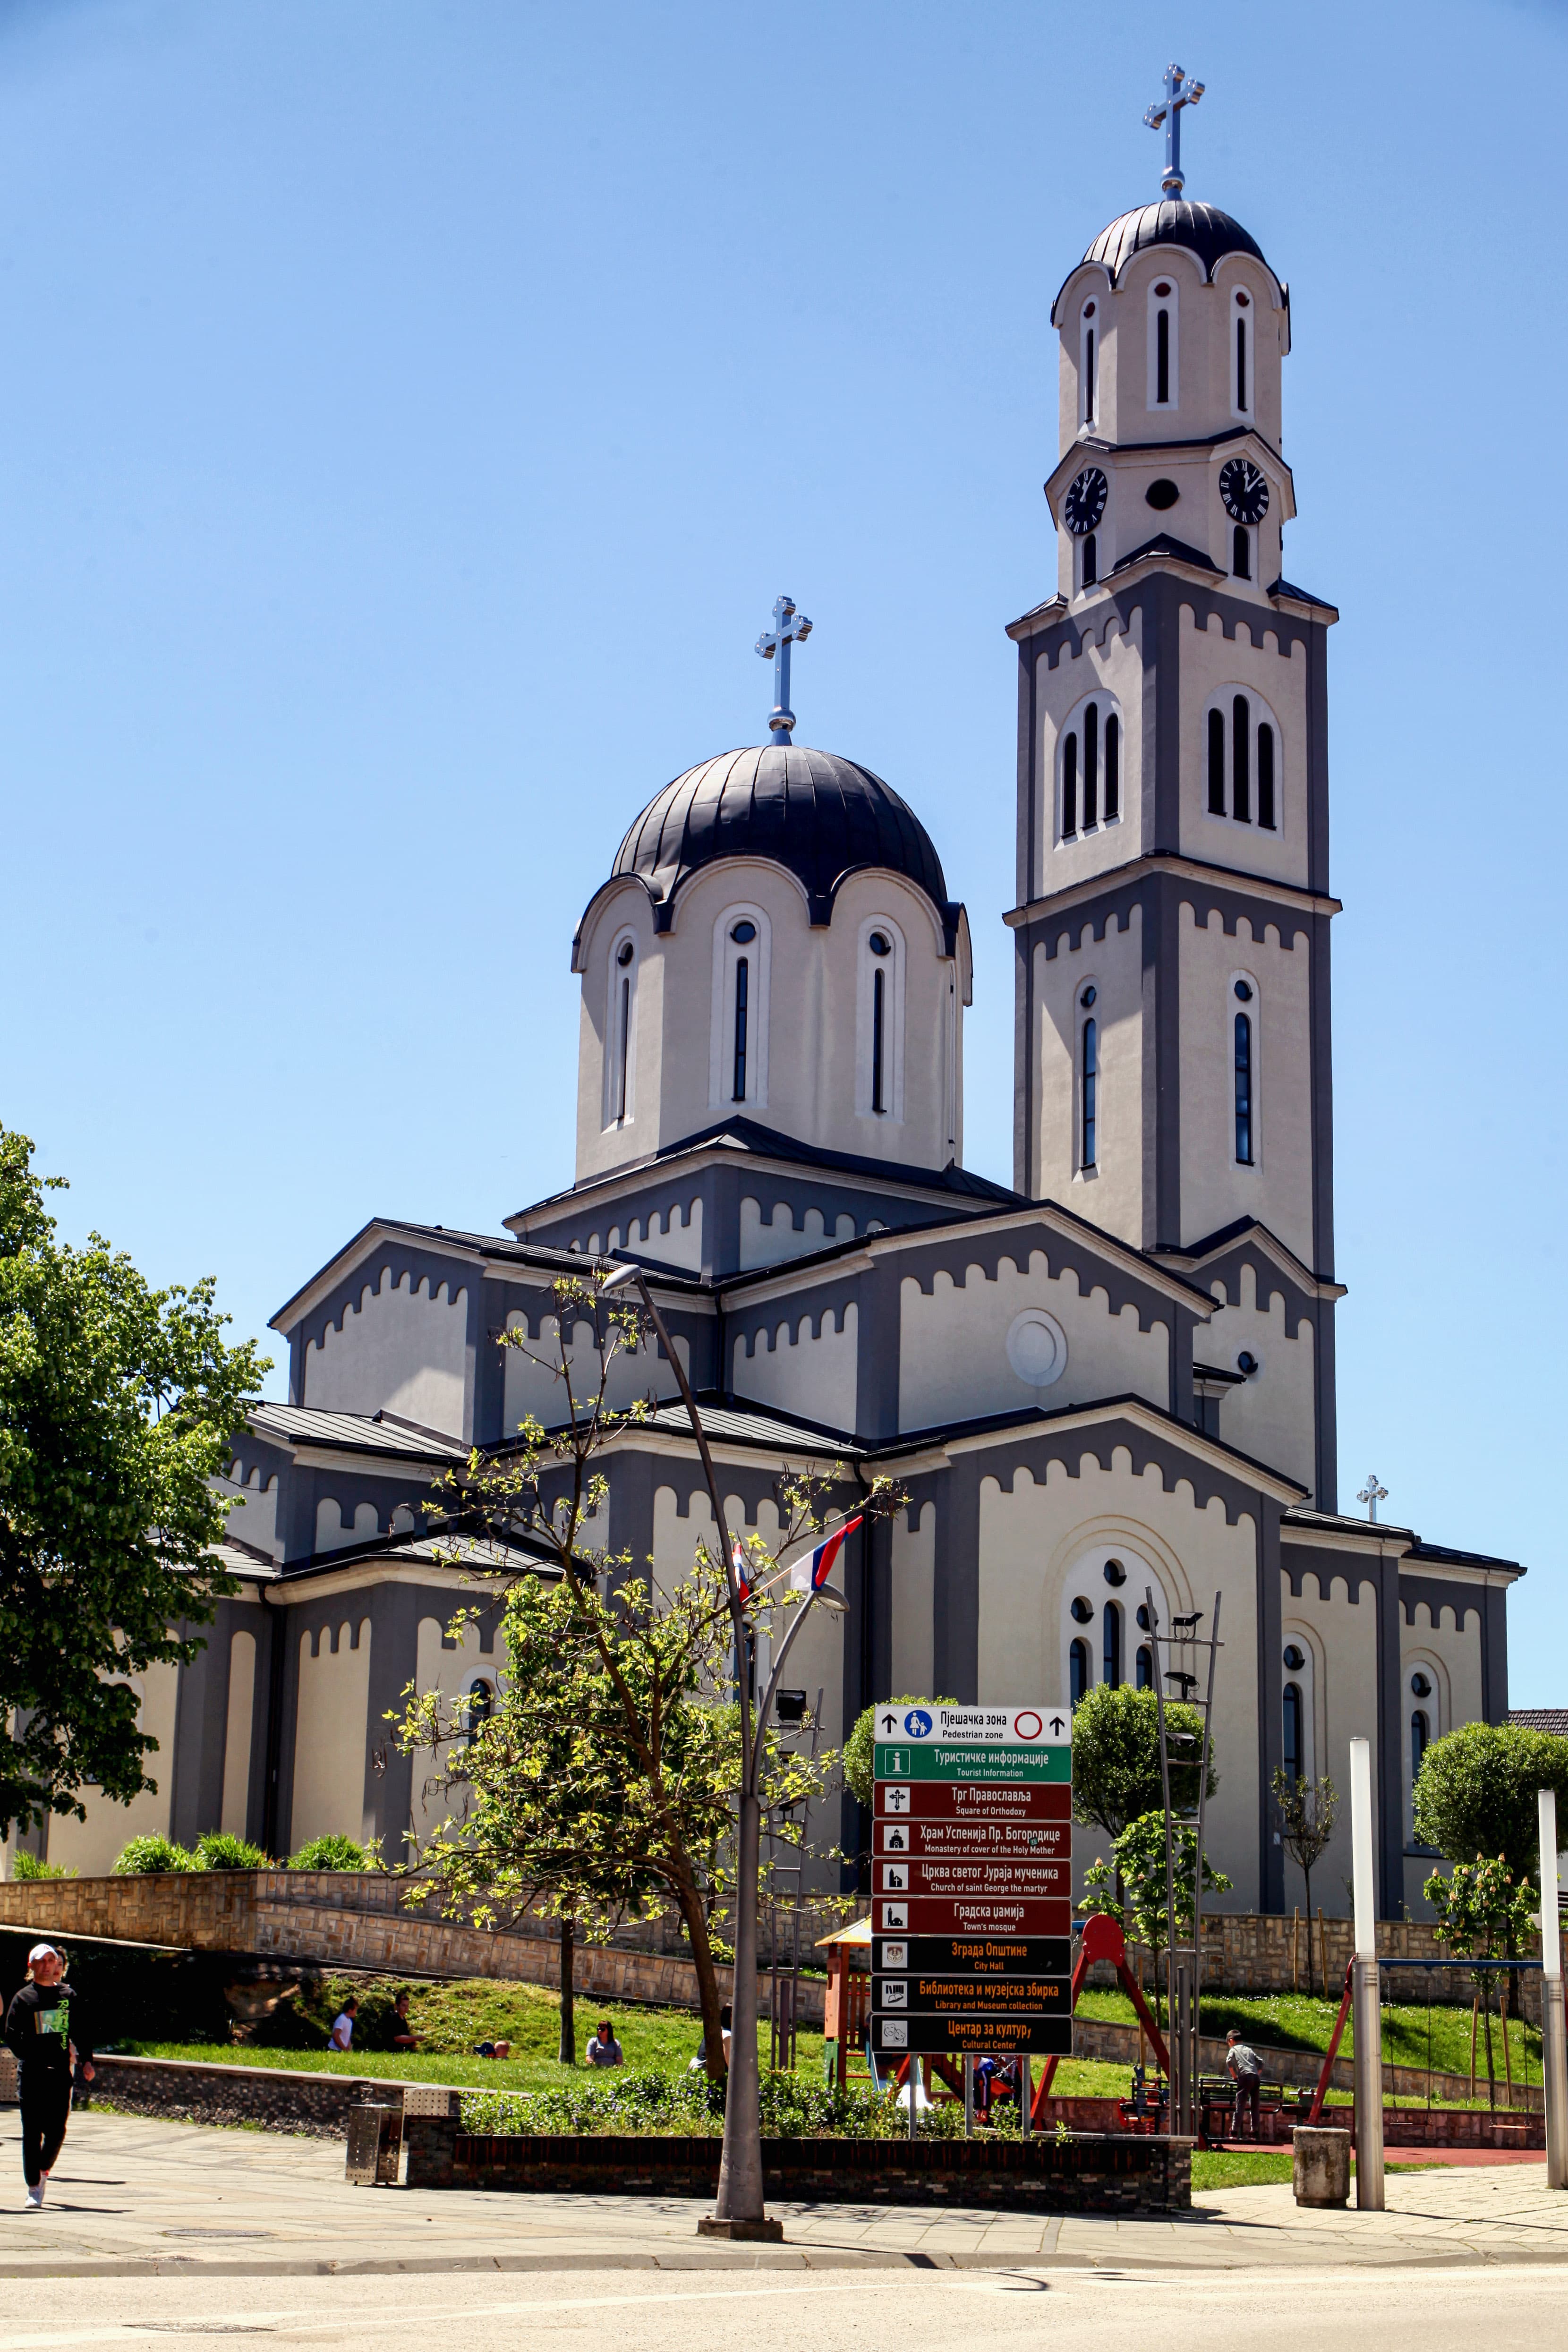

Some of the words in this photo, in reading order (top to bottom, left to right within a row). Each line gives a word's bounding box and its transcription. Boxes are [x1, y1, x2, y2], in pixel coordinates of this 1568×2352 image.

[941, 1711, 984, 1728] Пјешачка
[986, 1715, 1007, 1725] зона
[943, 1730, 983, 1738] Pedestrian
[934, 1749, 986, 1766] Туристичке
[989, 1750, 1048, 1768] информације
[957, 1768, 981, 1776] Tourist
[983, 1768, 1023, 1777] Information
[952, 1787, 967, 1804] Трг
[969, 1787, 1031, 1804] Православља
[956, 1806, 980, 1816] Square
[982, 1807, 989, 1815] of
[990, 1807, 1026, 1817] Orthodoxy
[920, 1825, 944, 1842] Храм
[946, 1825, 986, 1843] Успенија
[989, 1826, 1003, 1843] Пр.
[1006, 1826, 1060, 1844] Богородице
[925, 1844, 961, 1855] Monastery
[963, 1844, 970, 1853] of
[991, 1845, 999, 1853] of
[1000, 1845, 1011, 1854] the
[1013, 1845, 1028, 1856] Holy
[1030, 1846, 1055, 1854] Mother
[922, 1864, 950, 1881] Црква
[952, 1867, 982, 1878] светог
[983, 1865, 1012, 1882] Јураја
[1014, 1868, 1058, 1882] мученика
[931, 1883, 955, 1892] Church
[957, 1883, 964, 1892] of
[965, 1883, 983, 1892] saint
[984, 1883, 1009, 1894] George
[1010, 1883, 1022, 1892] the
[1023, 1884, 1048, 1894] martyr
[954, 1902, 991, 1920] Градска
[993, 1904, 1024, 1921] џамија
[963, 1922, 987, 1931] Town's
[989, 1924, 1016, 1933] mosque
[952, 1942, 984, 1959] Зграда
[986, 1942, 1027, 1956] Општине
[974, 1961, 988, 1972] City
[989, 1961, 1004, 1970] Hall
[920, 1980, 974, 1995] Библиотека
[976, 1985, 982, 1995] и
[985, 1982, 1024, 1999] музејска
[1026, 1982, 1059, 2000] збирка
[935, 2000, 961, 2011] Library
[963, 2001, 976, 2009] and
[977, 2001, 1007, 2010] Museum
[1008, 2001, 1043, 2010] collection
[948, 2020, 981, 2038] Центар
[984, 2024, 994, 2035] за
[996, 2024, 1031, 2039] културу
[962, 2040, 991, 2049] Cultural
[992, 2040, 1016, 2049] Center
